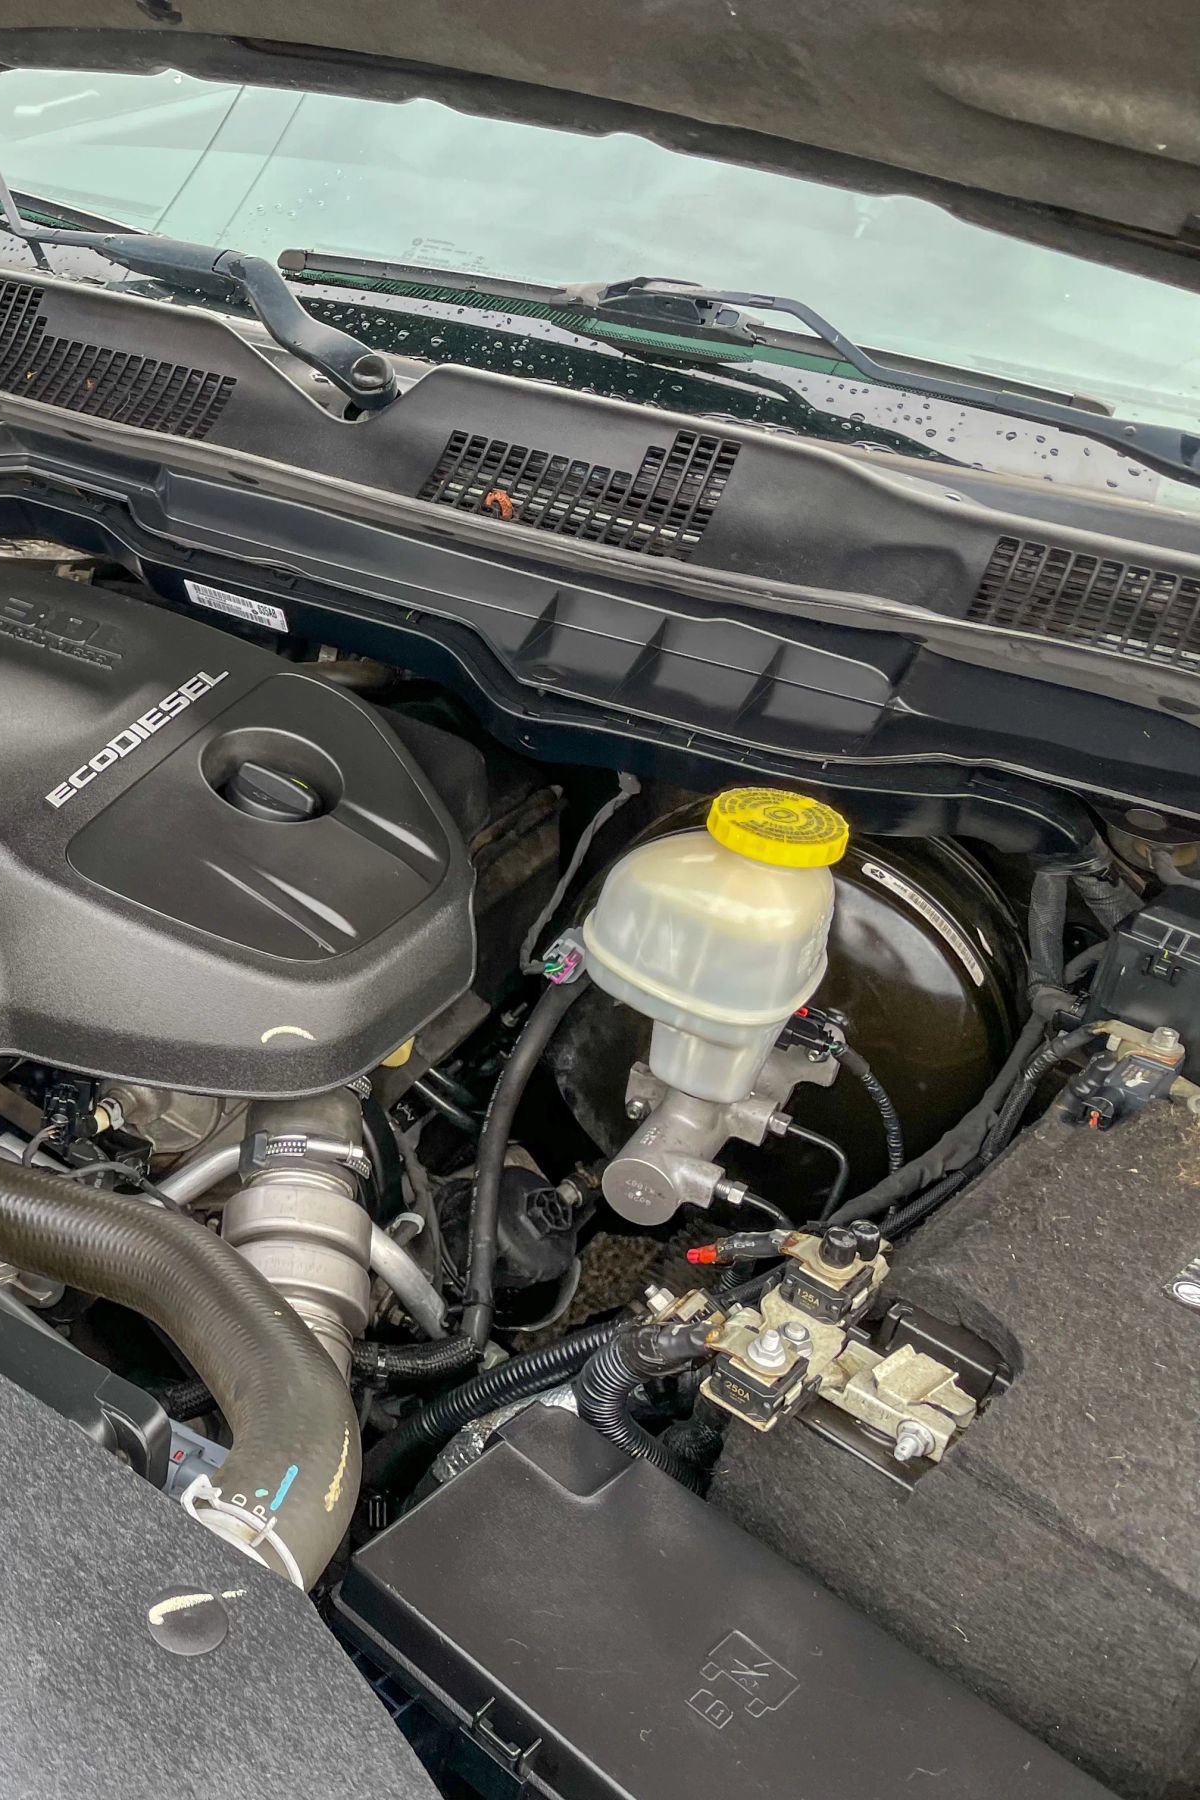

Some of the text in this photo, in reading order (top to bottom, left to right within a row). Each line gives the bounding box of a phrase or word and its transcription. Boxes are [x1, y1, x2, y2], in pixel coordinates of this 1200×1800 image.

[45, 671, 229, 808] ECODIESEL
[797, 1288, 820, 1307] 125A
[725, 1380, 750, 1401] 250A
